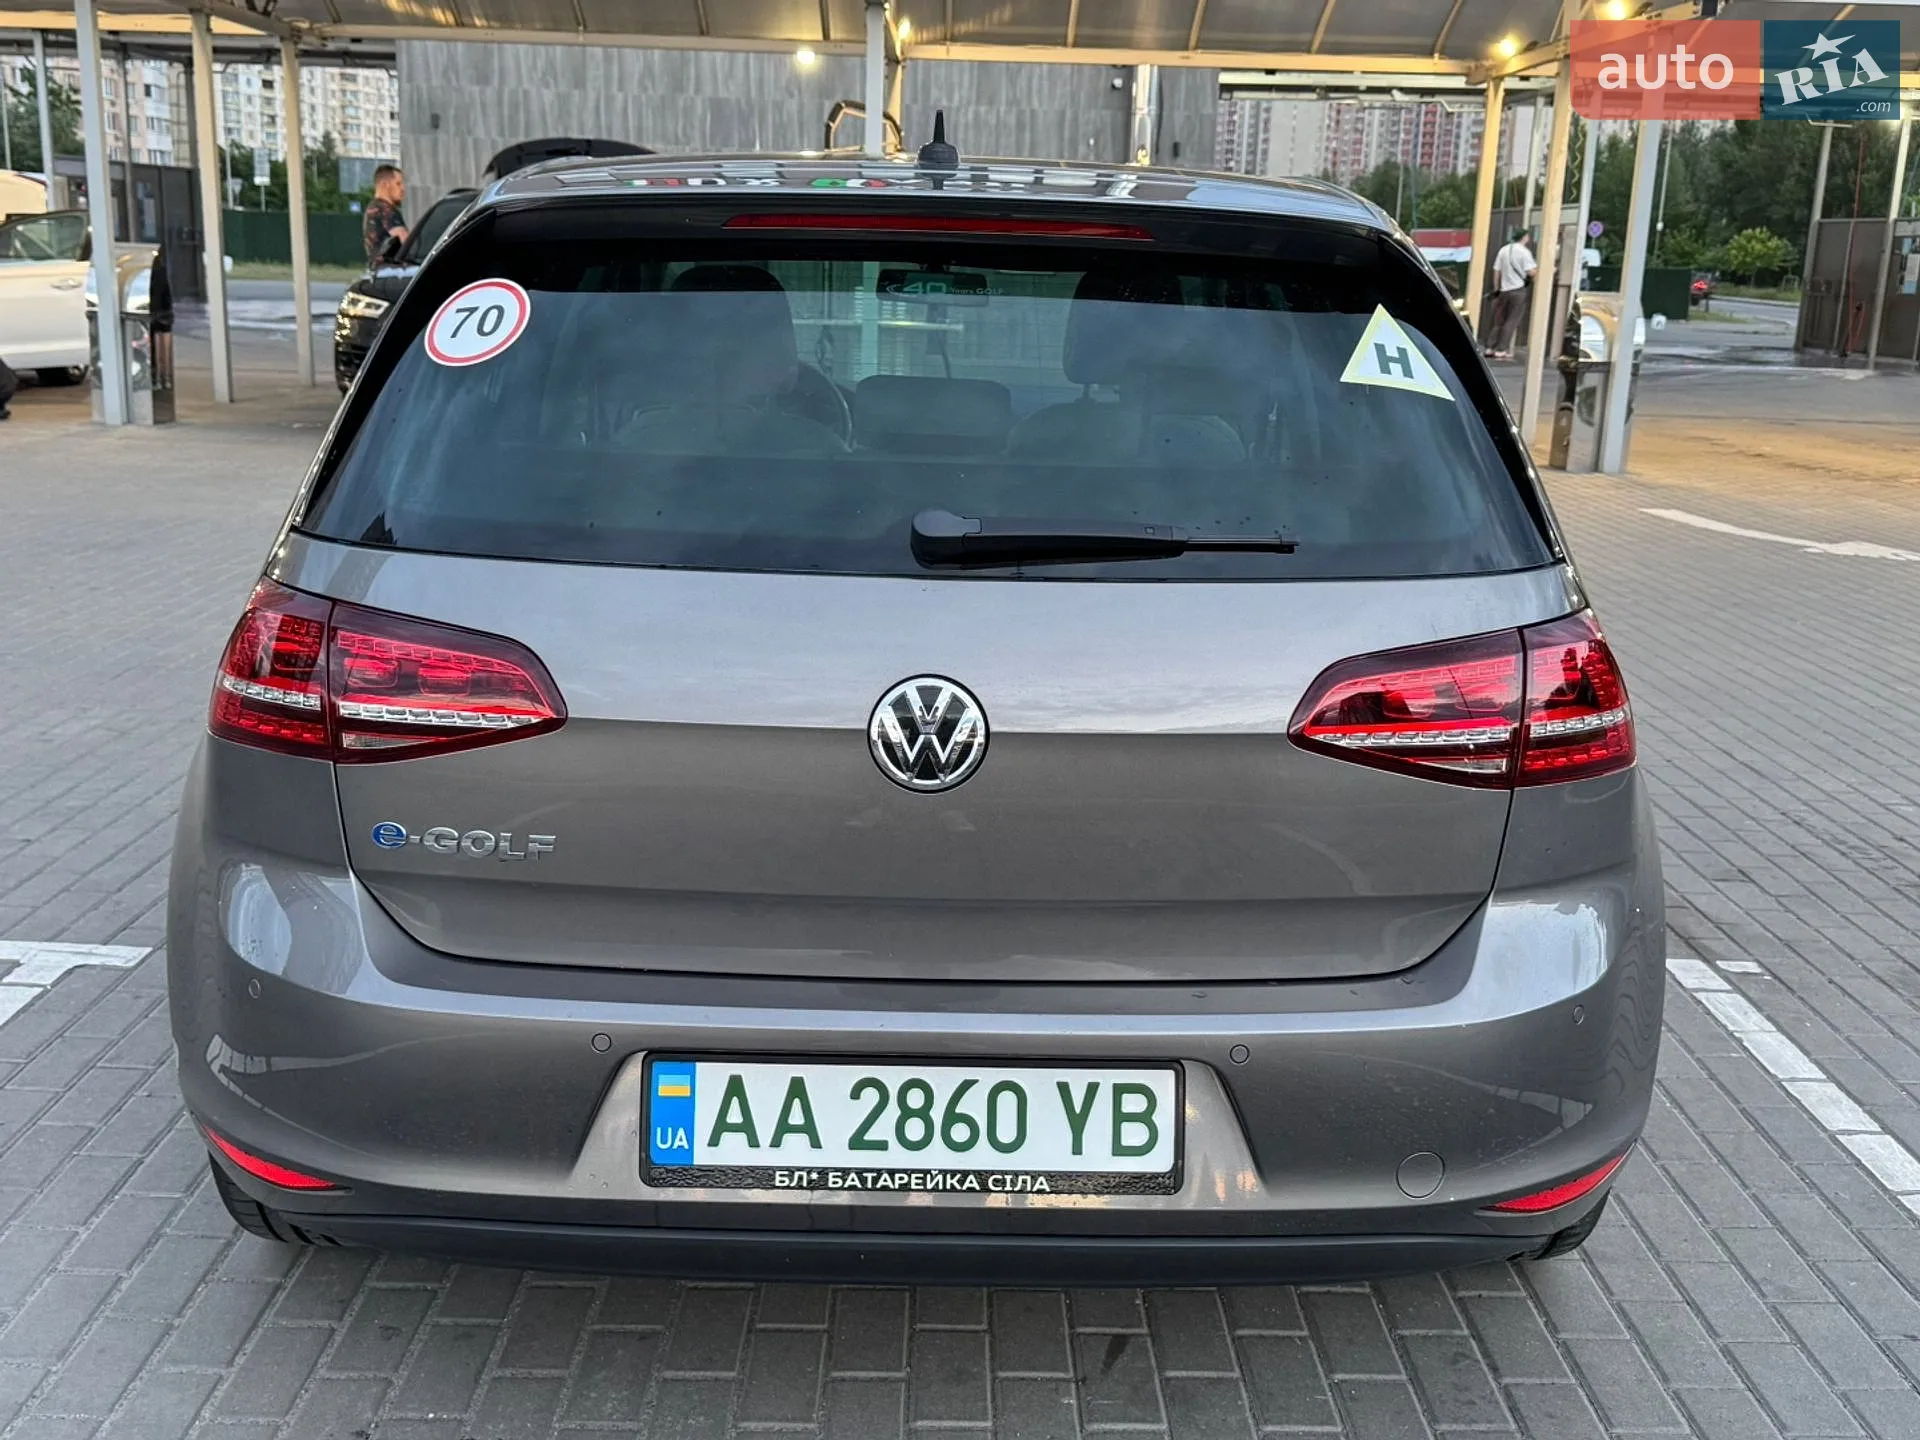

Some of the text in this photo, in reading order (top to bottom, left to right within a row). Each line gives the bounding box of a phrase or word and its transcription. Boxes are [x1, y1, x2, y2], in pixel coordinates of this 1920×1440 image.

[449, 304, 505, 339] 70
[706, 1074, 1160, 1157] AA 2860 YB
[656, 1127, 689, 1149] UA
[827, 1169, 981, 1191] БАТАРЕЙКА
